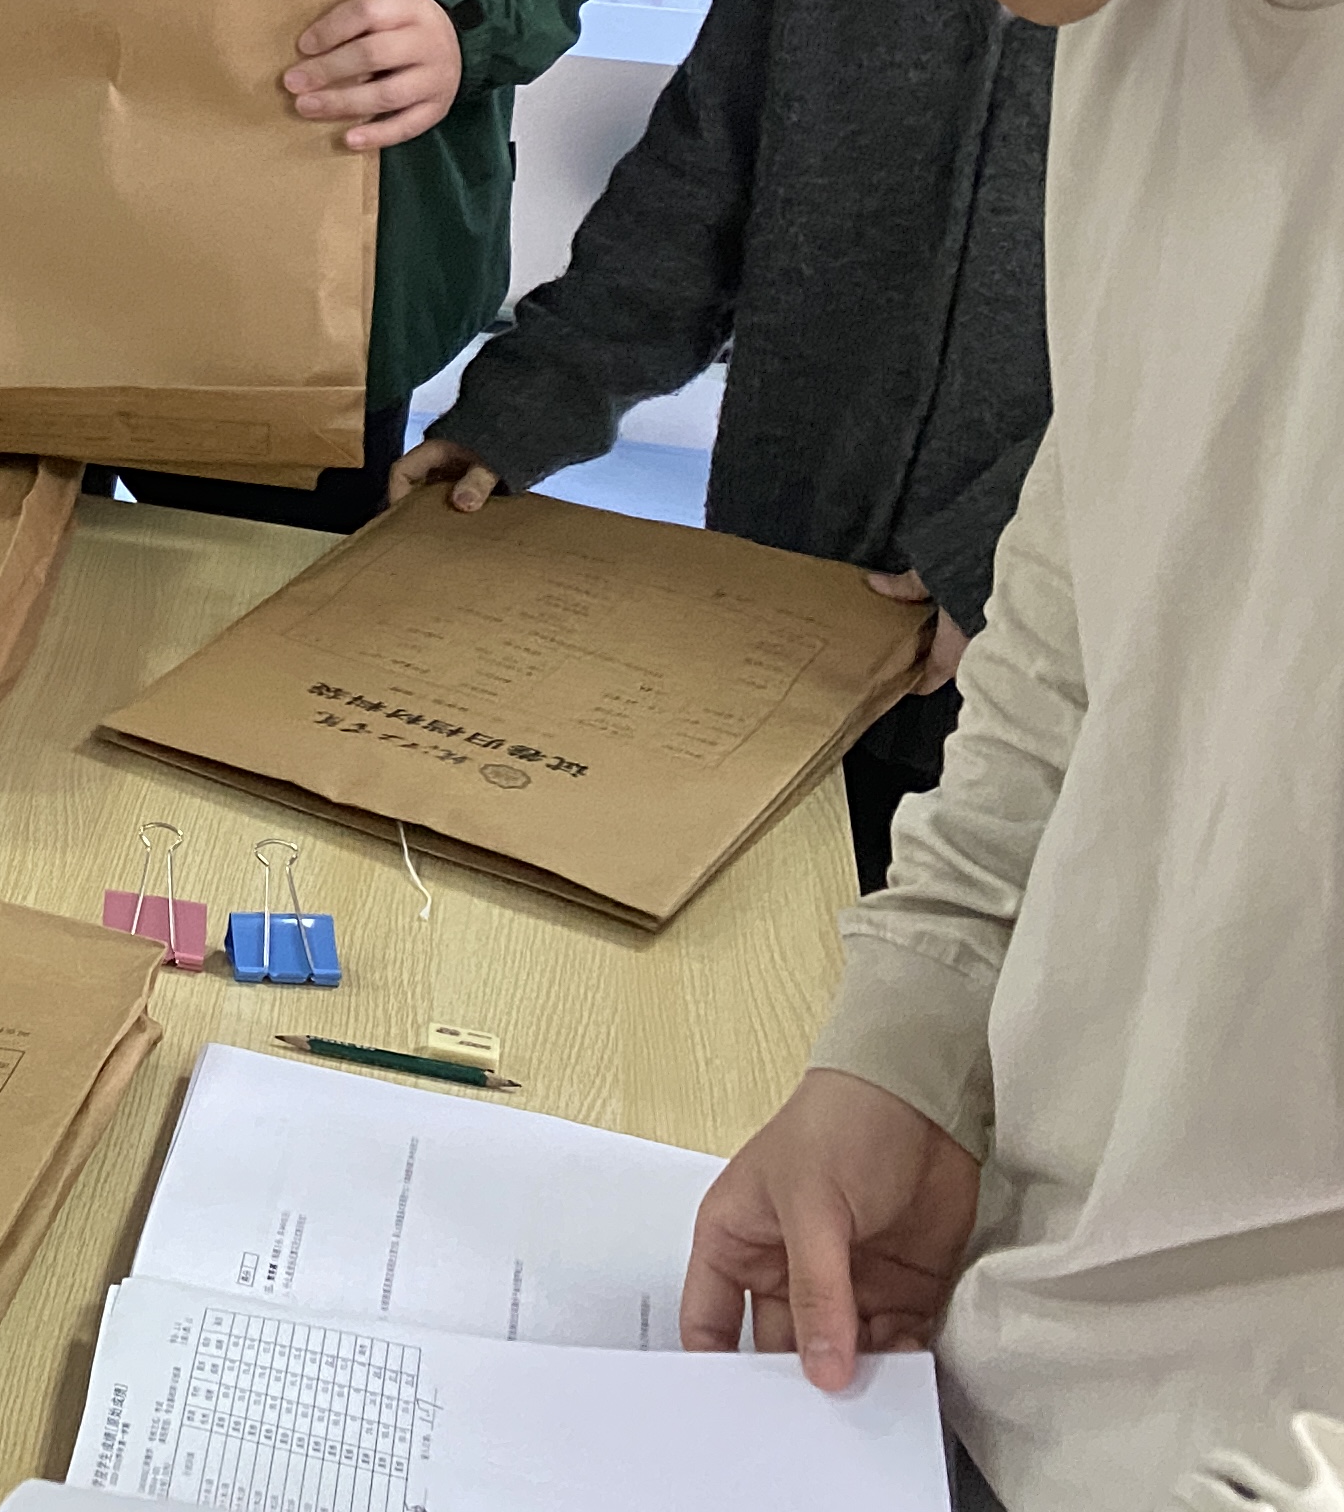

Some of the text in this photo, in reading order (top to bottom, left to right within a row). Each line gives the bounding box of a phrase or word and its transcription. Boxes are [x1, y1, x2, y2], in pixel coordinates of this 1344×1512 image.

[307, 682, 588, 777] 试卷归档材料袋
